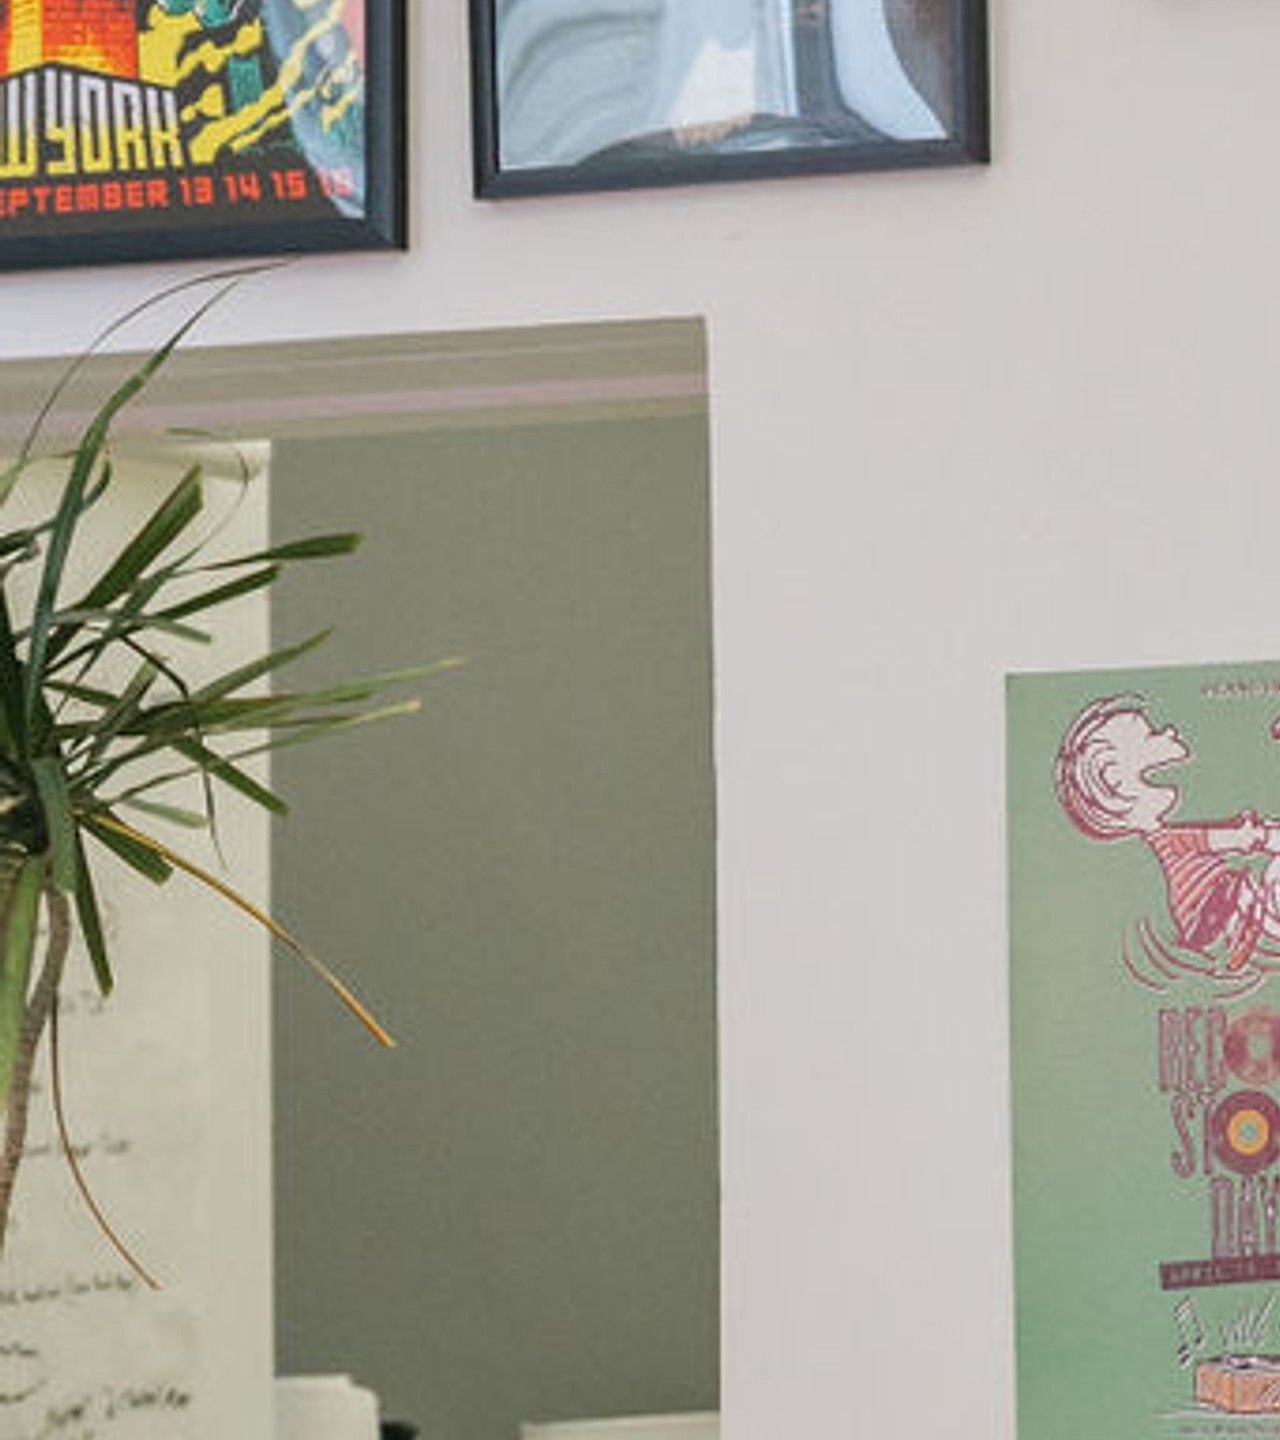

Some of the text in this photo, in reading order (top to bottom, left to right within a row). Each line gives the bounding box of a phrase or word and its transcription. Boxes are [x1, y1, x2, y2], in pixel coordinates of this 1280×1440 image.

[179, 175, 214, 206] 13
[223, 172, 261, 205] 14
[271, 169, 307, 202] 15
